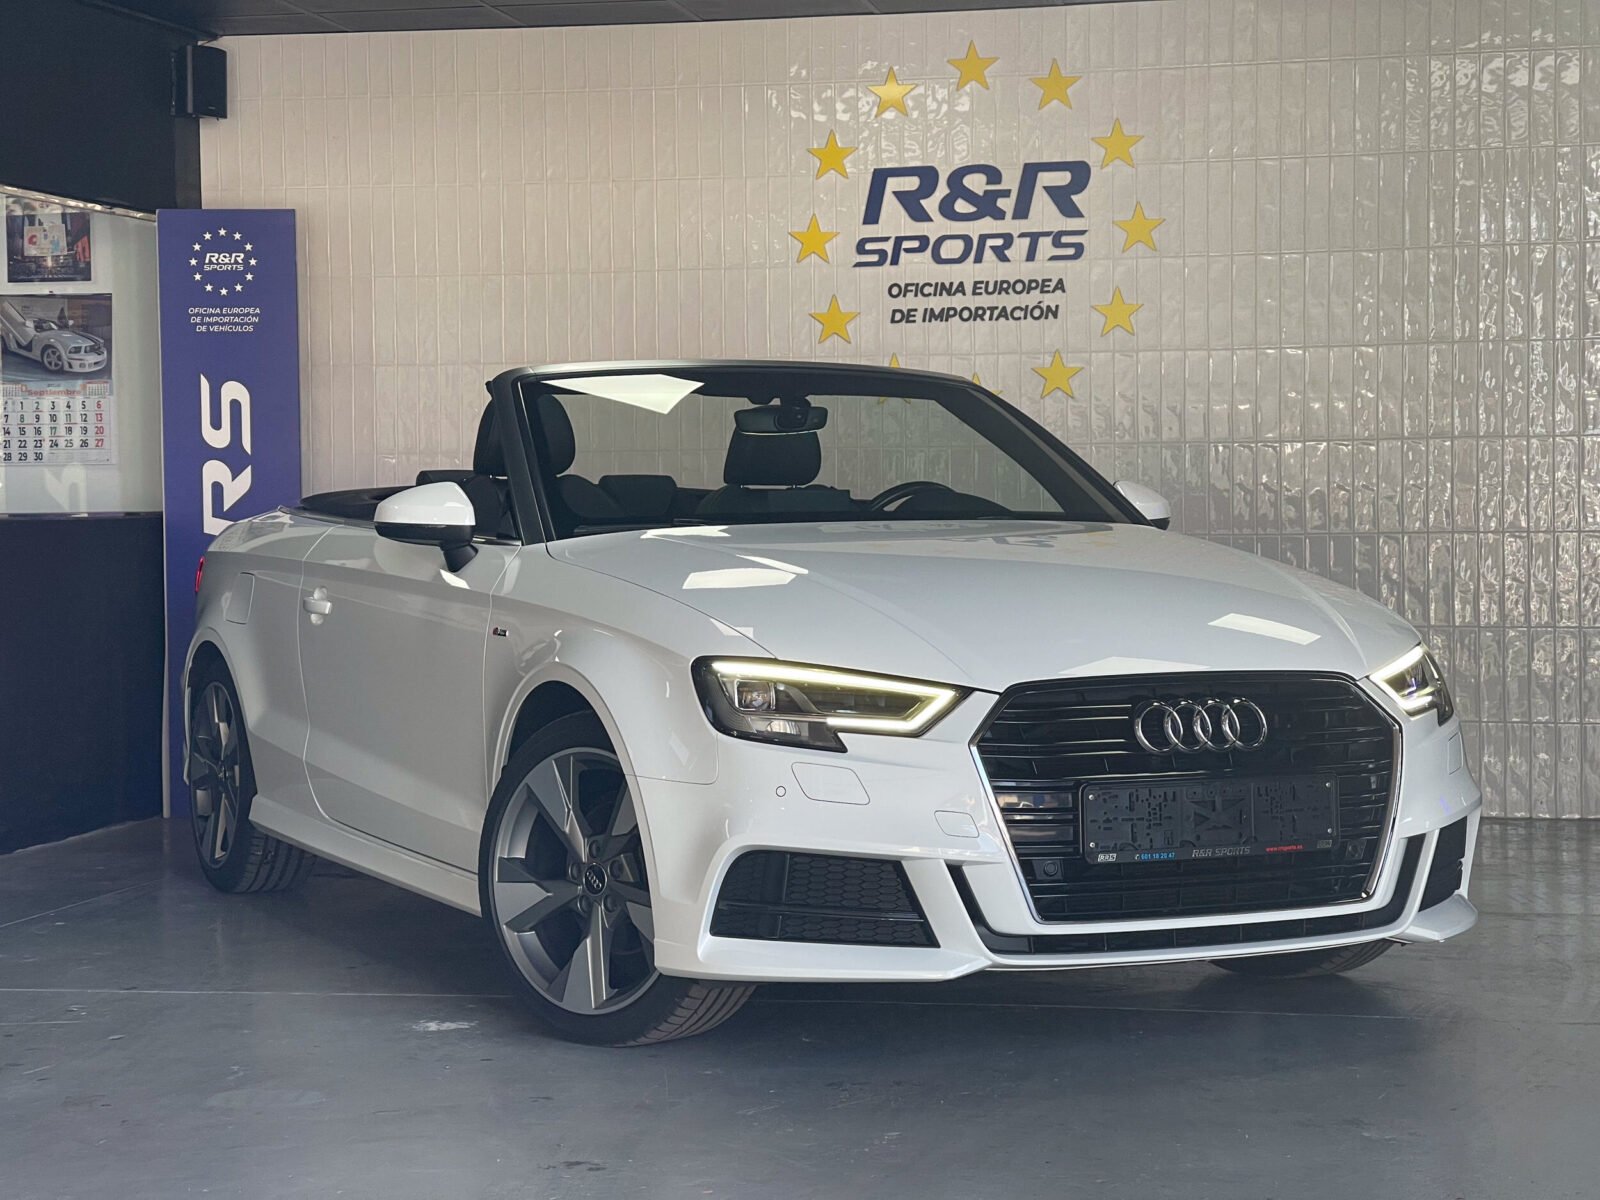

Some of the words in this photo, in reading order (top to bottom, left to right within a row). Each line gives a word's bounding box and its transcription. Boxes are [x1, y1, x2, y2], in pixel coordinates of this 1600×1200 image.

[861, 160, 1092, 226] R&R
[852, 229, 1089, 268] SPORTS
[204, 252, 245, 264] R&R
[887, 281, 966, 298] OFICINA
[971, 277, 1066, 296] EUROPEA
[890, 307, 917, 324] DE
[922, 301, 1060, 323] IMPORTACIÓN
[203, 315, 259, 323] IMPORTACIÓN
[209, 324, 254, 332] VEHÍCULOS
[49, 413, 57, 423] 10
[65, 413, 72, 423] 11
[80, 413, 88, 423] 12
[95, 412, 103, 422] 13
[3, 427, 11, 436] 14
[18, 427, 26, 436] 15
[33, 427, 42, 436] 16
[49, 426, 57, 435] 17
[64, 426, 73, 435] 18
[80, 426, 88, 435] 19
[95, 426, 104, 435] 20
[3, 440, 11, 449] 21
[18, 440, 27, 449] 22
[33, 439, 43, 448] 23
[49, 439, 58, 448] 24
[64, 439, 74, 448] 25
[80, 439, 89, 448] 26
[95, 438, 104, 447] 27
[3, 453, 12, 462] 28
[18, 452, 28, 461] 29
[33, 452, 43, 461] 30
